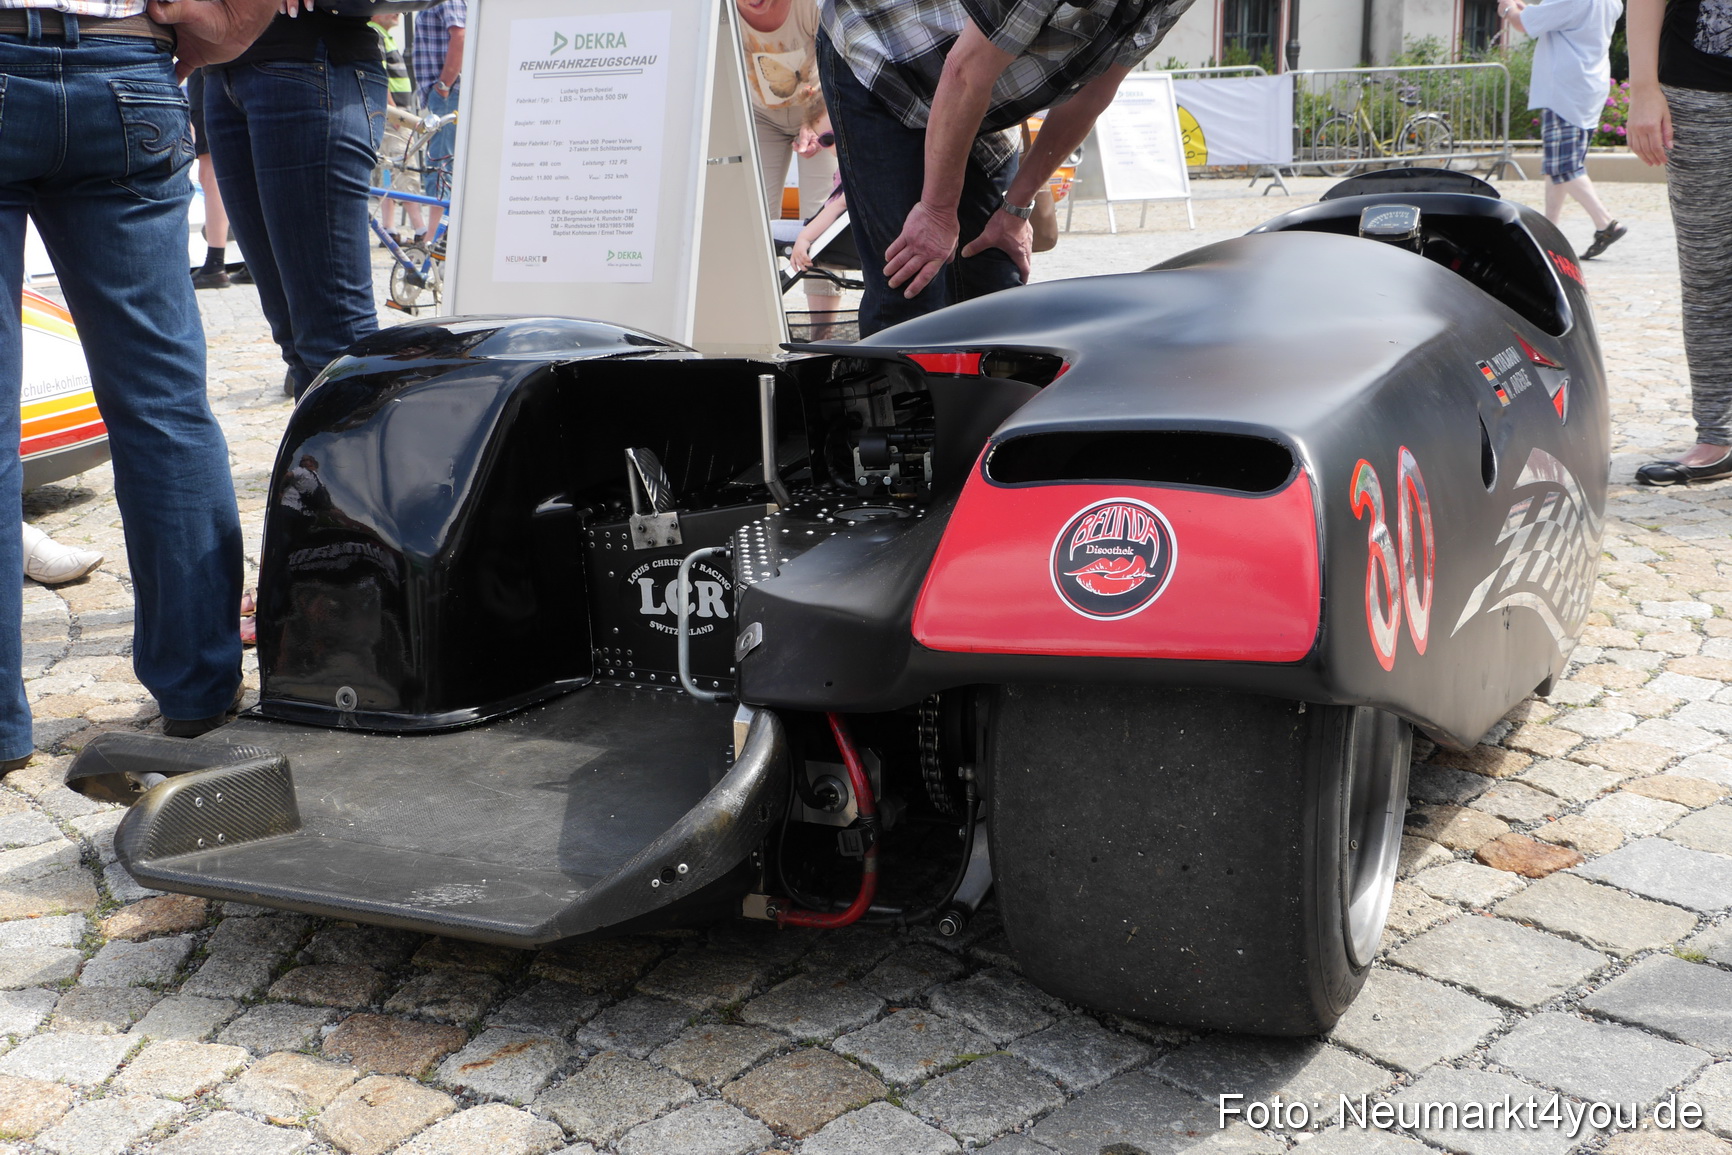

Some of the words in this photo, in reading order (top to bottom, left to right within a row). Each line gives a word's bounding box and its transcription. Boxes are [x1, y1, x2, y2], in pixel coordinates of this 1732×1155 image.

[574, 32, 627, 50] DEKRA
[519, 55, 658, 71] RENNFAHRZEUGSCHAU
[506, 256, 541, 264] NEUMARKT
[617, 251, 642, 259] DEKRA
[1070, 505, 1160, 568] BELINDA
[1086, 544, 1135, 556] Discothek
[1350, 445, 1435, 672] 30
[627, 563, 650, 585] LOUIS
[652, 558, 697, 569] CHRISTN
[699, 563, 732, 591] RACING
[637, 577, 729, 619] LCR
[649, 620, 714, 636] SWITZLAND
